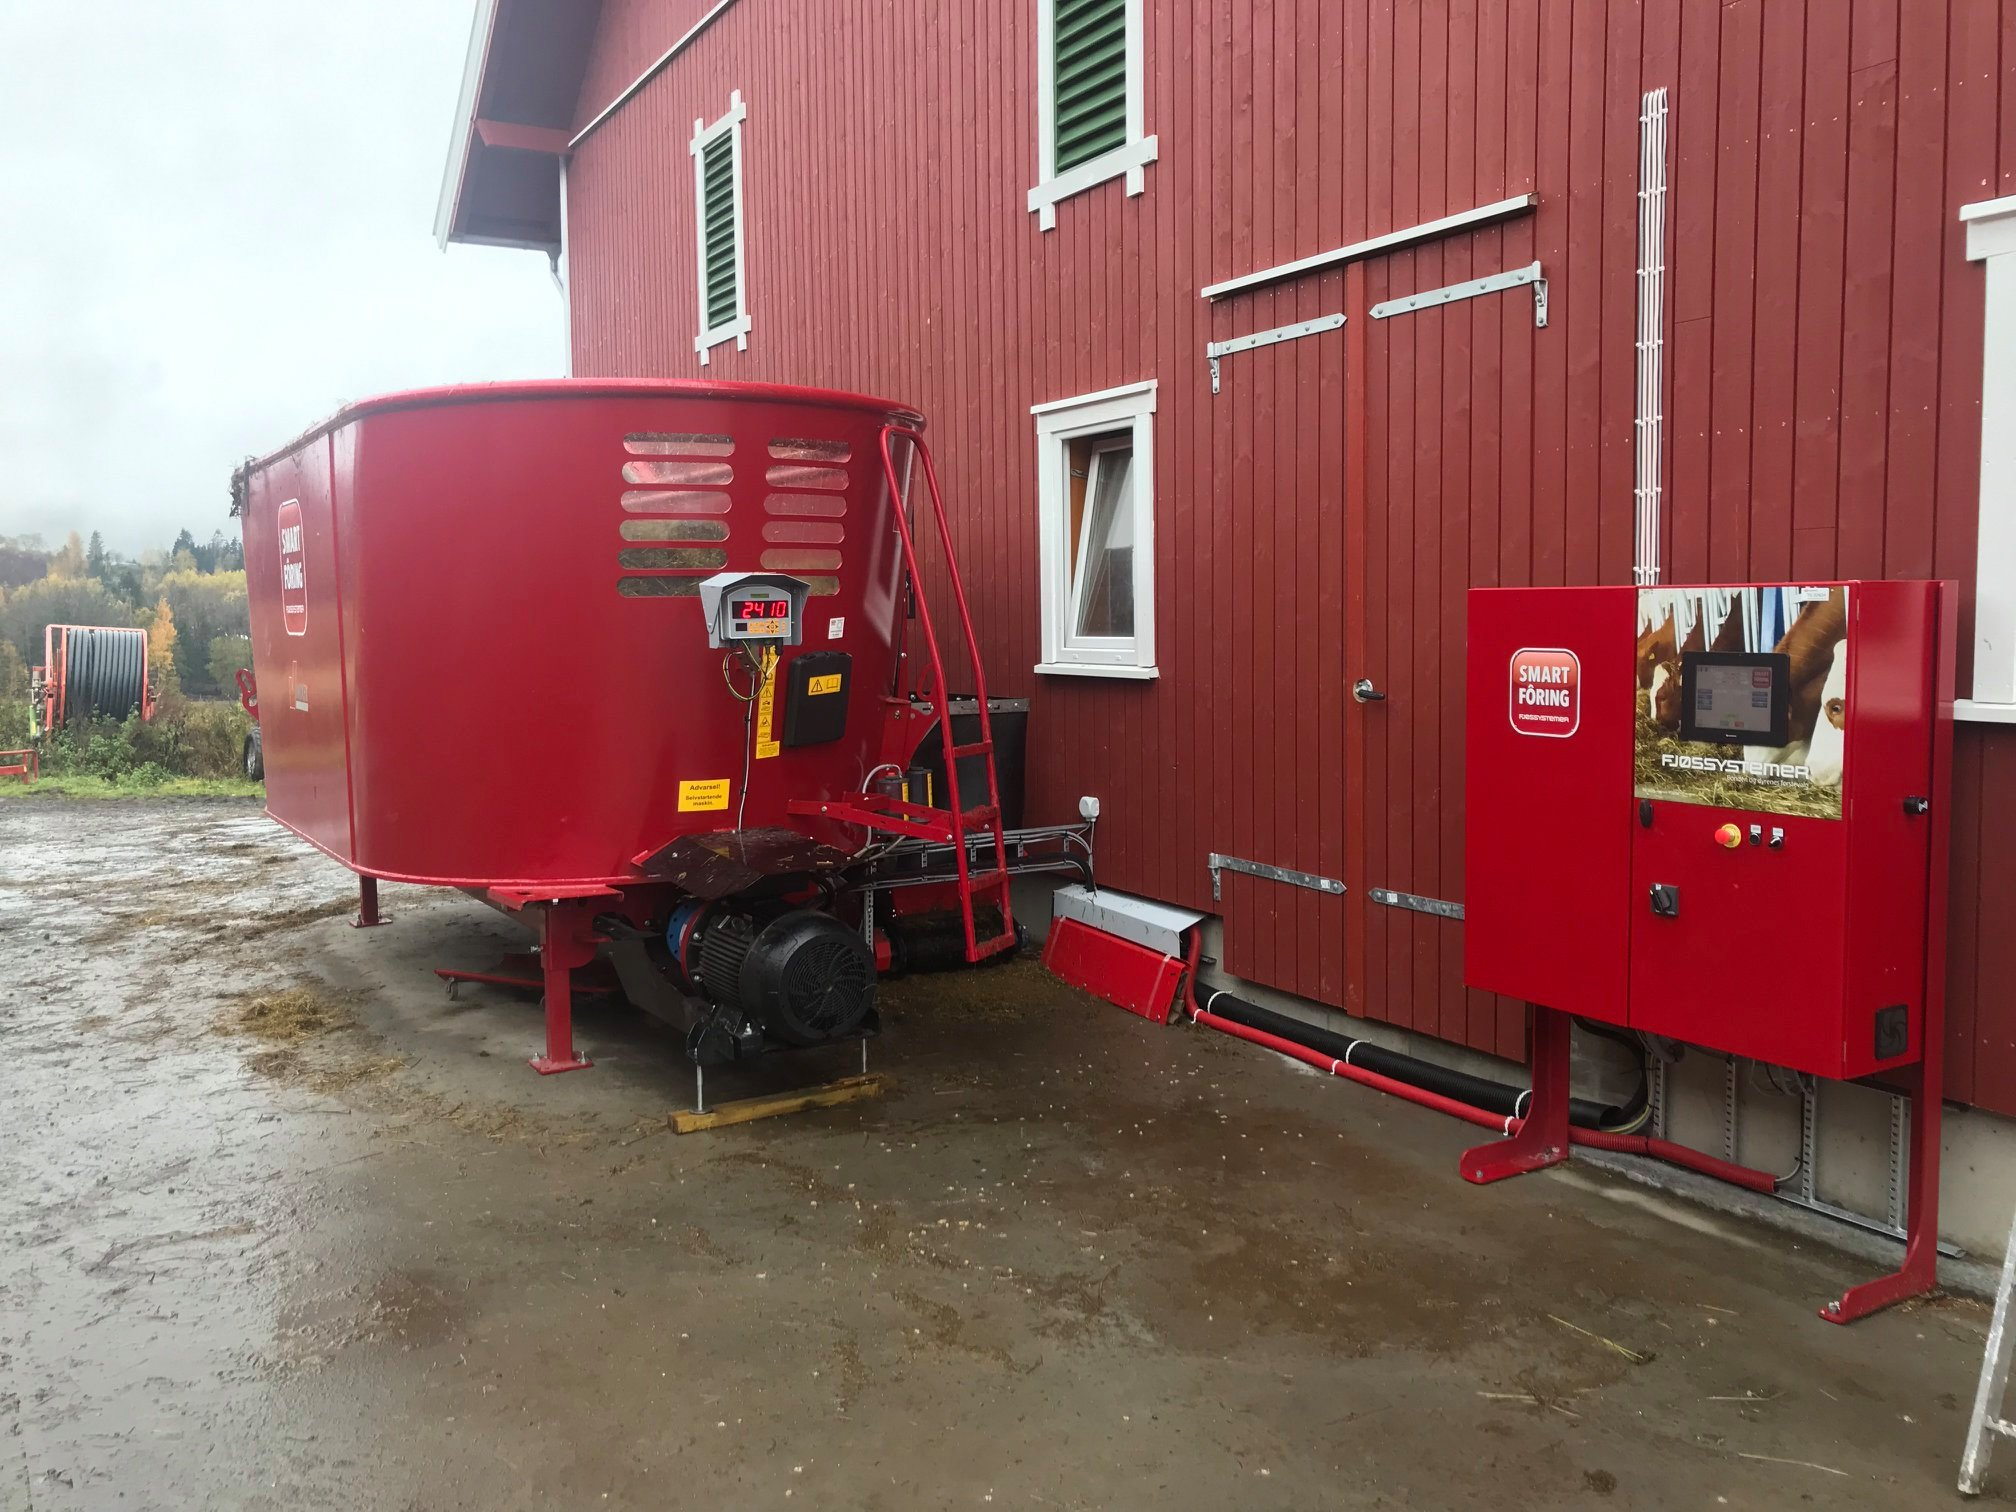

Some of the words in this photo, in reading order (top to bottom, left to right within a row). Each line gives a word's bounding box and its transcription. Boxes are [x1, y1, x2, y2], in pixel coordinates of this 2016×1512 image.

[281, 525, 301, 555] SMART
[742, 601, 787, 619] 2410
[1519, 664, 1570, 684] SMART
[1518, 683, 1570, 708] FÔRING
